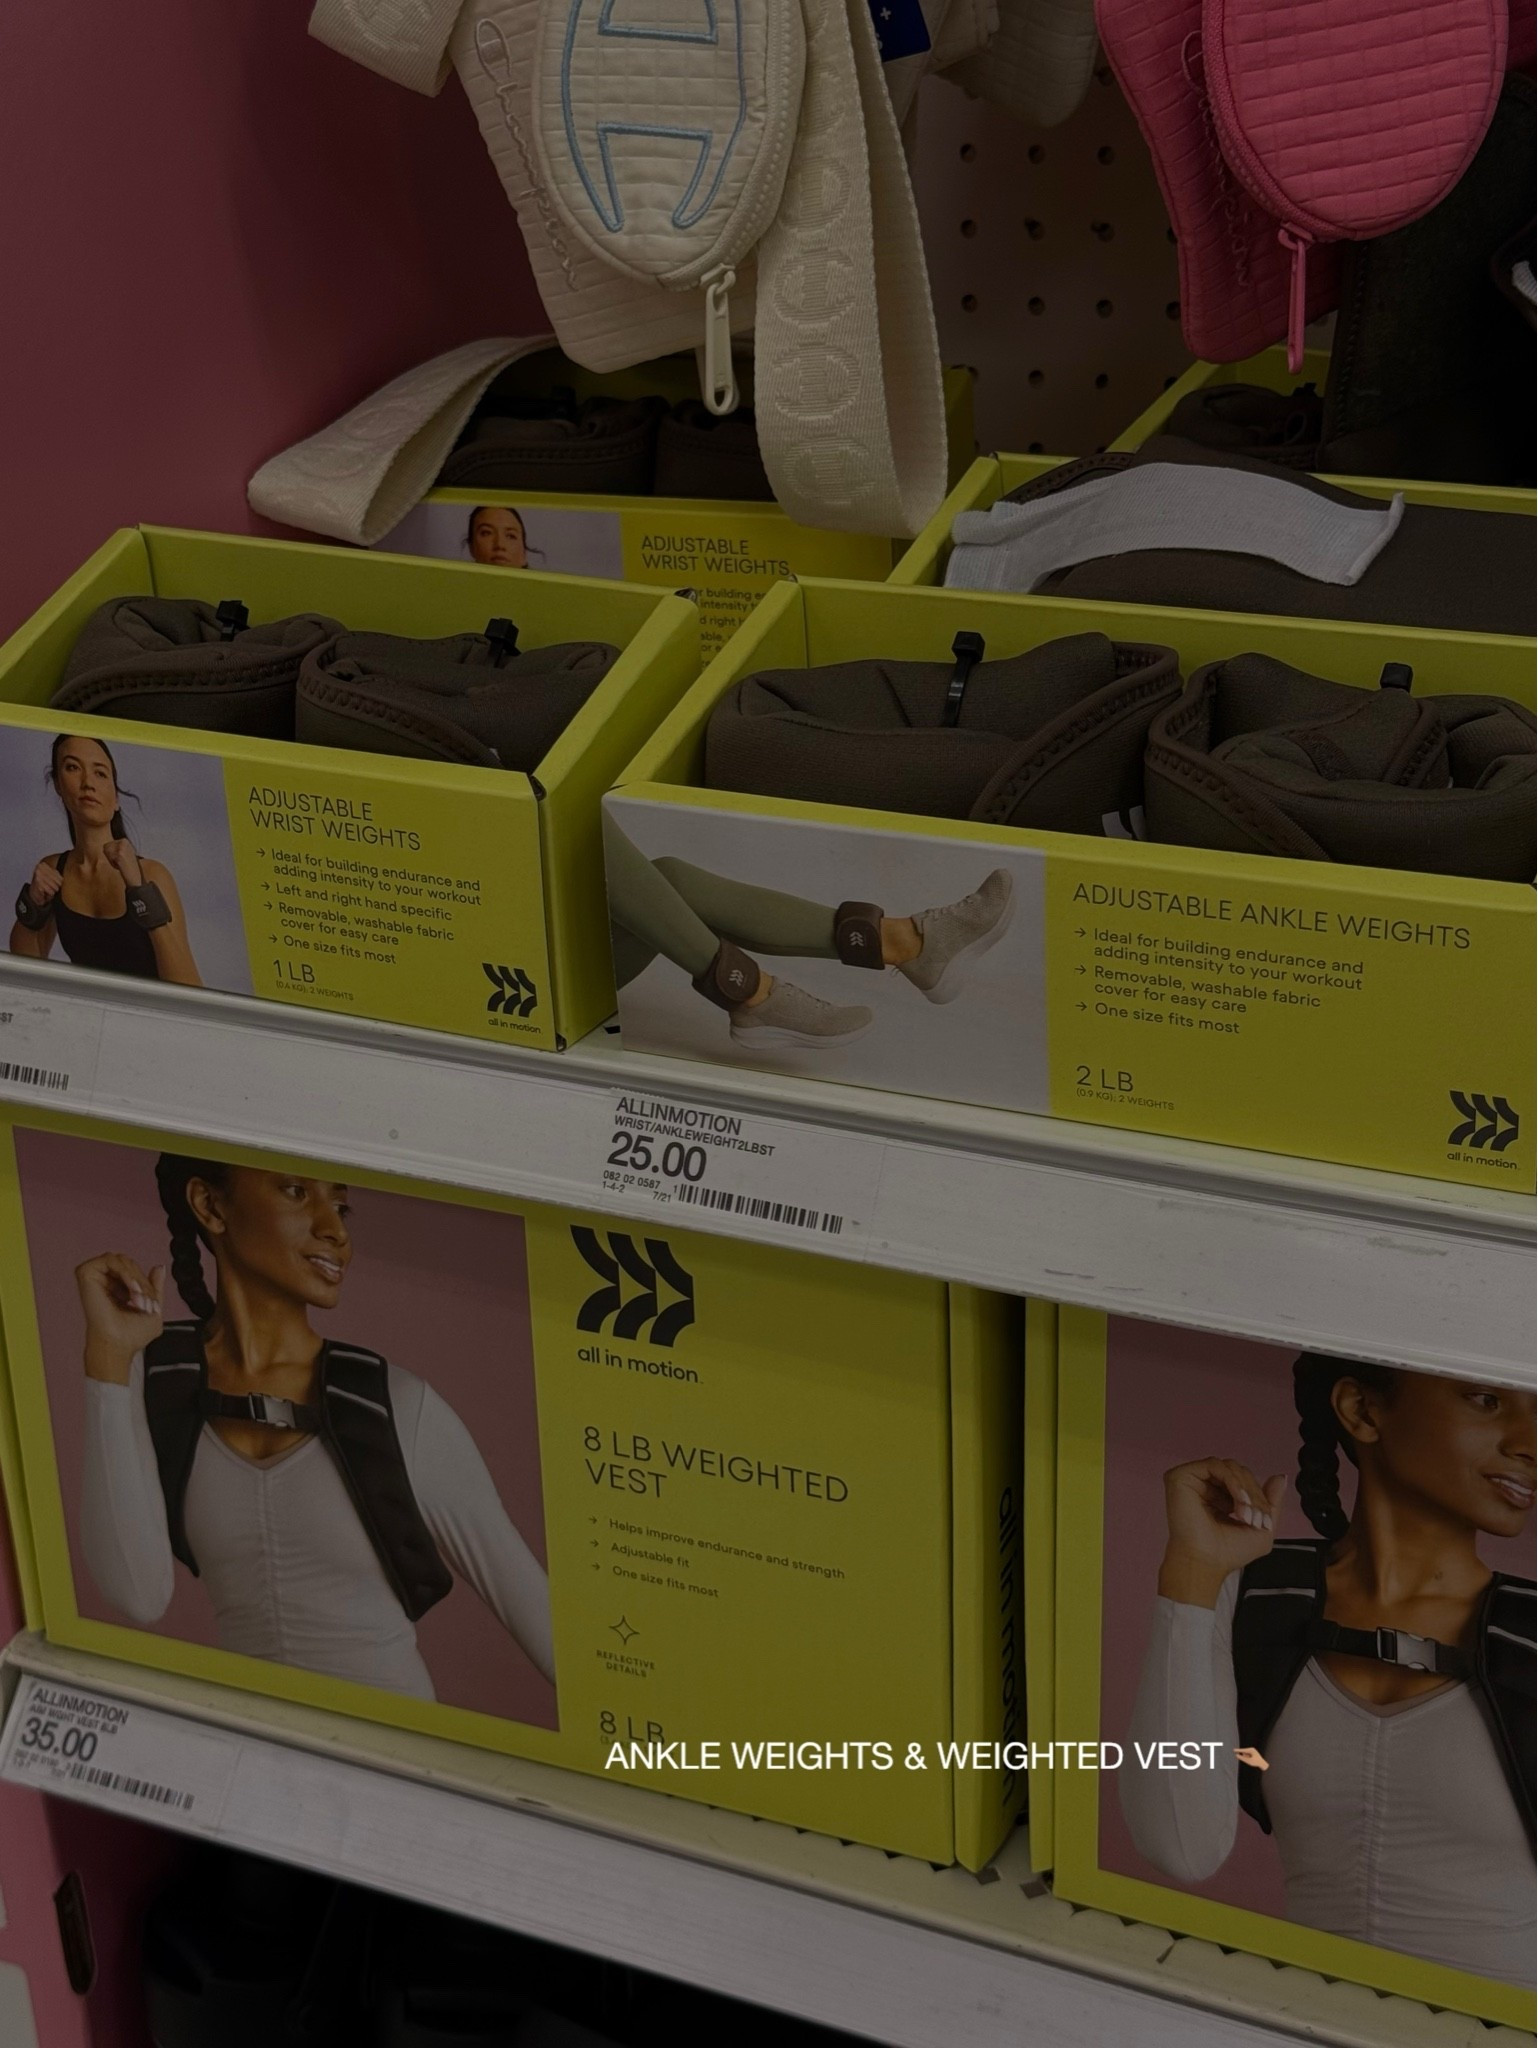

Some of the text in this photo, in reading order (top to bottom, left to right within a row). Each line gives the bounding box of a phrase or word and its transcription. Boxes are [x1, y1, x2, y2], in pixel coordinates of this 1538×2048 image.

[641, 535, 749, 556] ADJUSTABLE
[641, 554, 790, 576] WRIST WEIGHTS
[706, 588, 752, 602] building
[709, 616, 735, 628] right
[249, 785, 374, 823] ADJUSTABLE
[249, 808, 422, 852] WRIST WEIGHTS
[271, 848, 481, 892] Ideal for building endurance and
[273, 864, 482, 907] adding intensity to your workout
[275, 881, 453, 922] Left and right hand specific
[1072, 882, 1471, 950] ADJUSTABLE ANKLE WEIGHTS
[278, 902, 455, 942] Removable, washable fabric
[280, 917, 400, 947] cover for easy care
[283, 935, 396, 965] One size fits most
[1093, 945, 1363, 992] adding intensity to your workout
[1094, 927, 1364, 976] Ideal for building endurance and
[273, 959, 316, 984] 1 LB
[1095, 965, 1322, 1009] Removable, washable fabric
[1094, 983, 1247, 1014] cover for easy care
[488, 1017, 541, 1034] all in motion
[1095, 1002, 1240, 1035] One size fits most
[1076, 1065, 1134, 1093] 2 LB
[616, 1096, 742, 1136] ALLINMOTION
[1119, 1094, 1126, 1104] 2
[1127, 1095, 1175, 1111] WEIGHTS
[614, 1114, 776, 1157] WRIST/ANKLEWEIGHT2LBST
[607, 1131, 708, 1182] 25.00
[1446, 1151, 1518, 1171] all in motion
[602, 1179, 673, 1203] 1-4-2 7/21
[603, 1169, 662, 1191] 082 02 0587
[577, 1346, 700, 1385] all in motion
[583, 1425, 849, 1503] 8 LB WEIGHTED
[584, 1457, 668, 1499] VEST
[1000, 1487, 1019, 1553] all
[608, 1517, 846, 1580] Helps improve endurance and strength
[610, 1541, 690, 1569] Adjustable fit
[612, 1564, 720, 1599] One size fits most
[596, 1649, 655, 1670] REFLECTIVE
[606, 1662, 648, 1678] DETAILS
[32, 1688, 130, 1726] ALLINMOTION
[21, 1716, 98, 1762] 35.00
[600, 1710, 666, 1746] 8 LB
